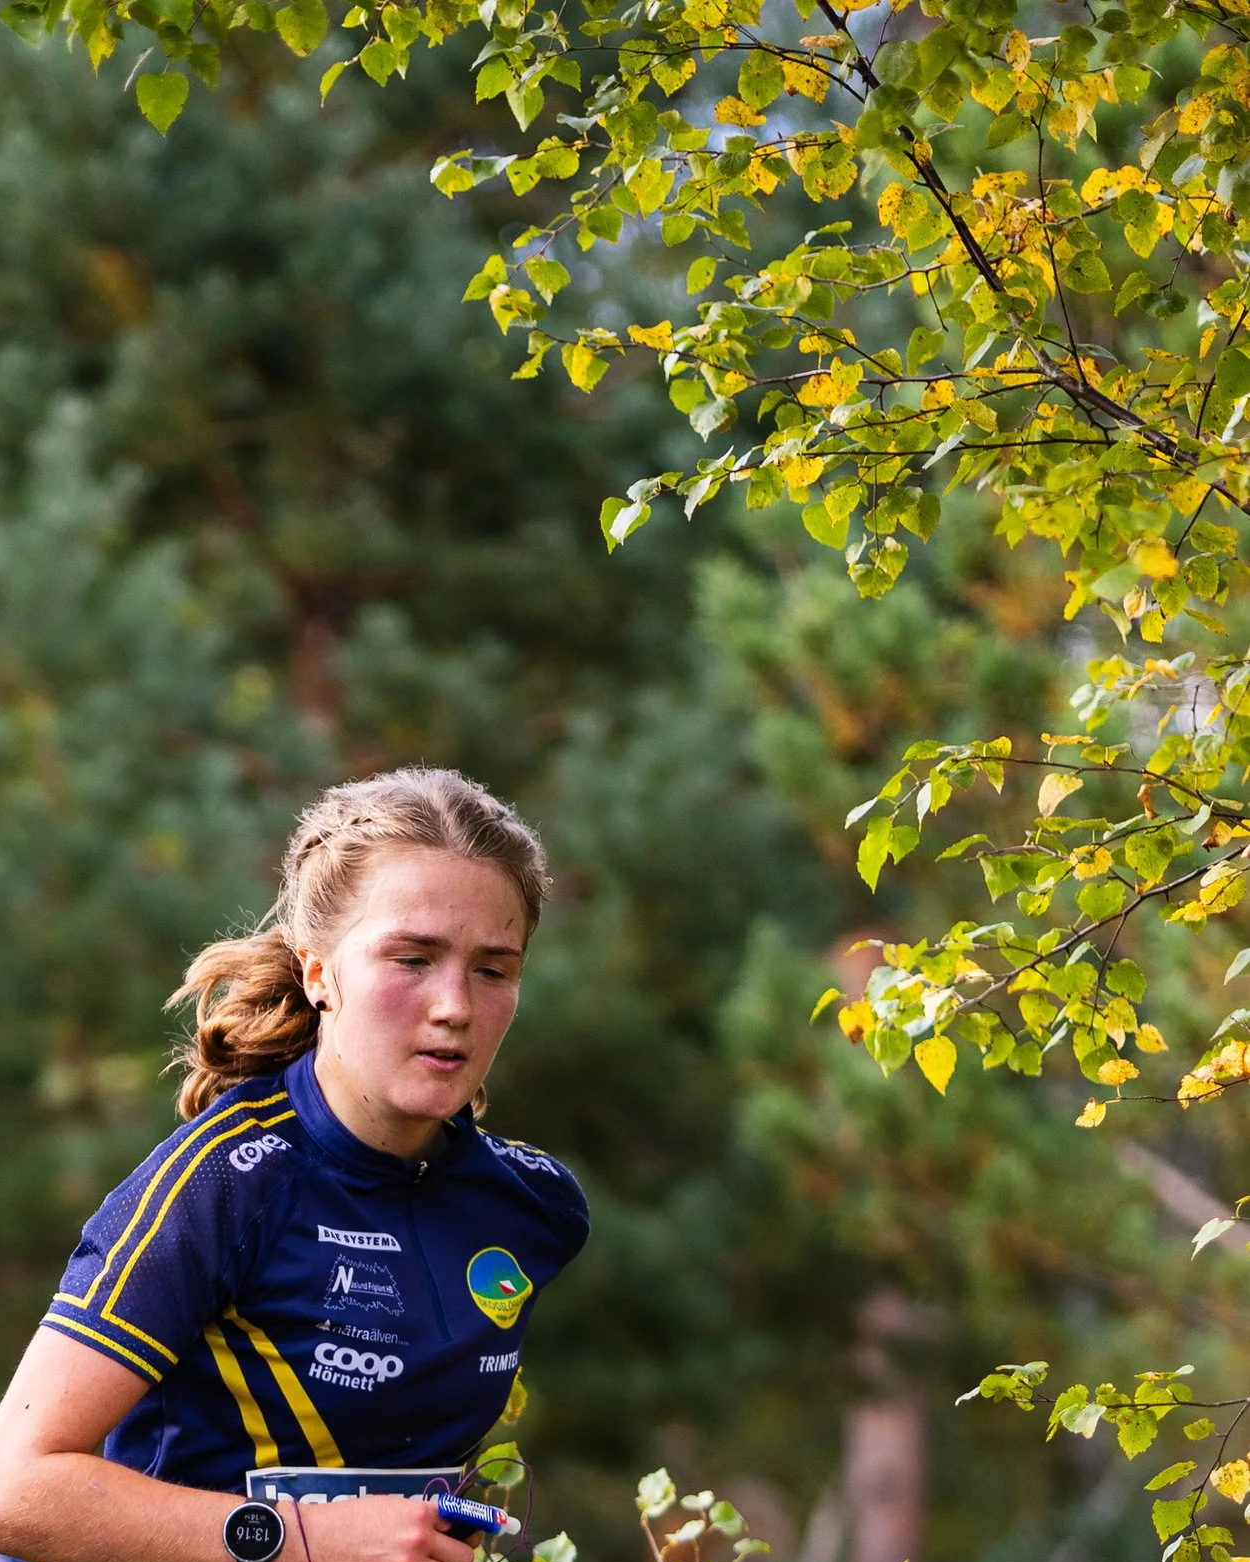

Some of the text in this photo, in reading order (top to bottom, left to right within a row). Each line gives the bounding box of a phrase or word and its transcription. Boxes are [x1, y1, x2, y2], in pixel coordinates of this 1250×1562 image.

[343, 1235, 396, 1247] SYSTEMS
[308, 1362, 376, 1392] Hörnett
[236, 1526, 270, 1541] 13:16
